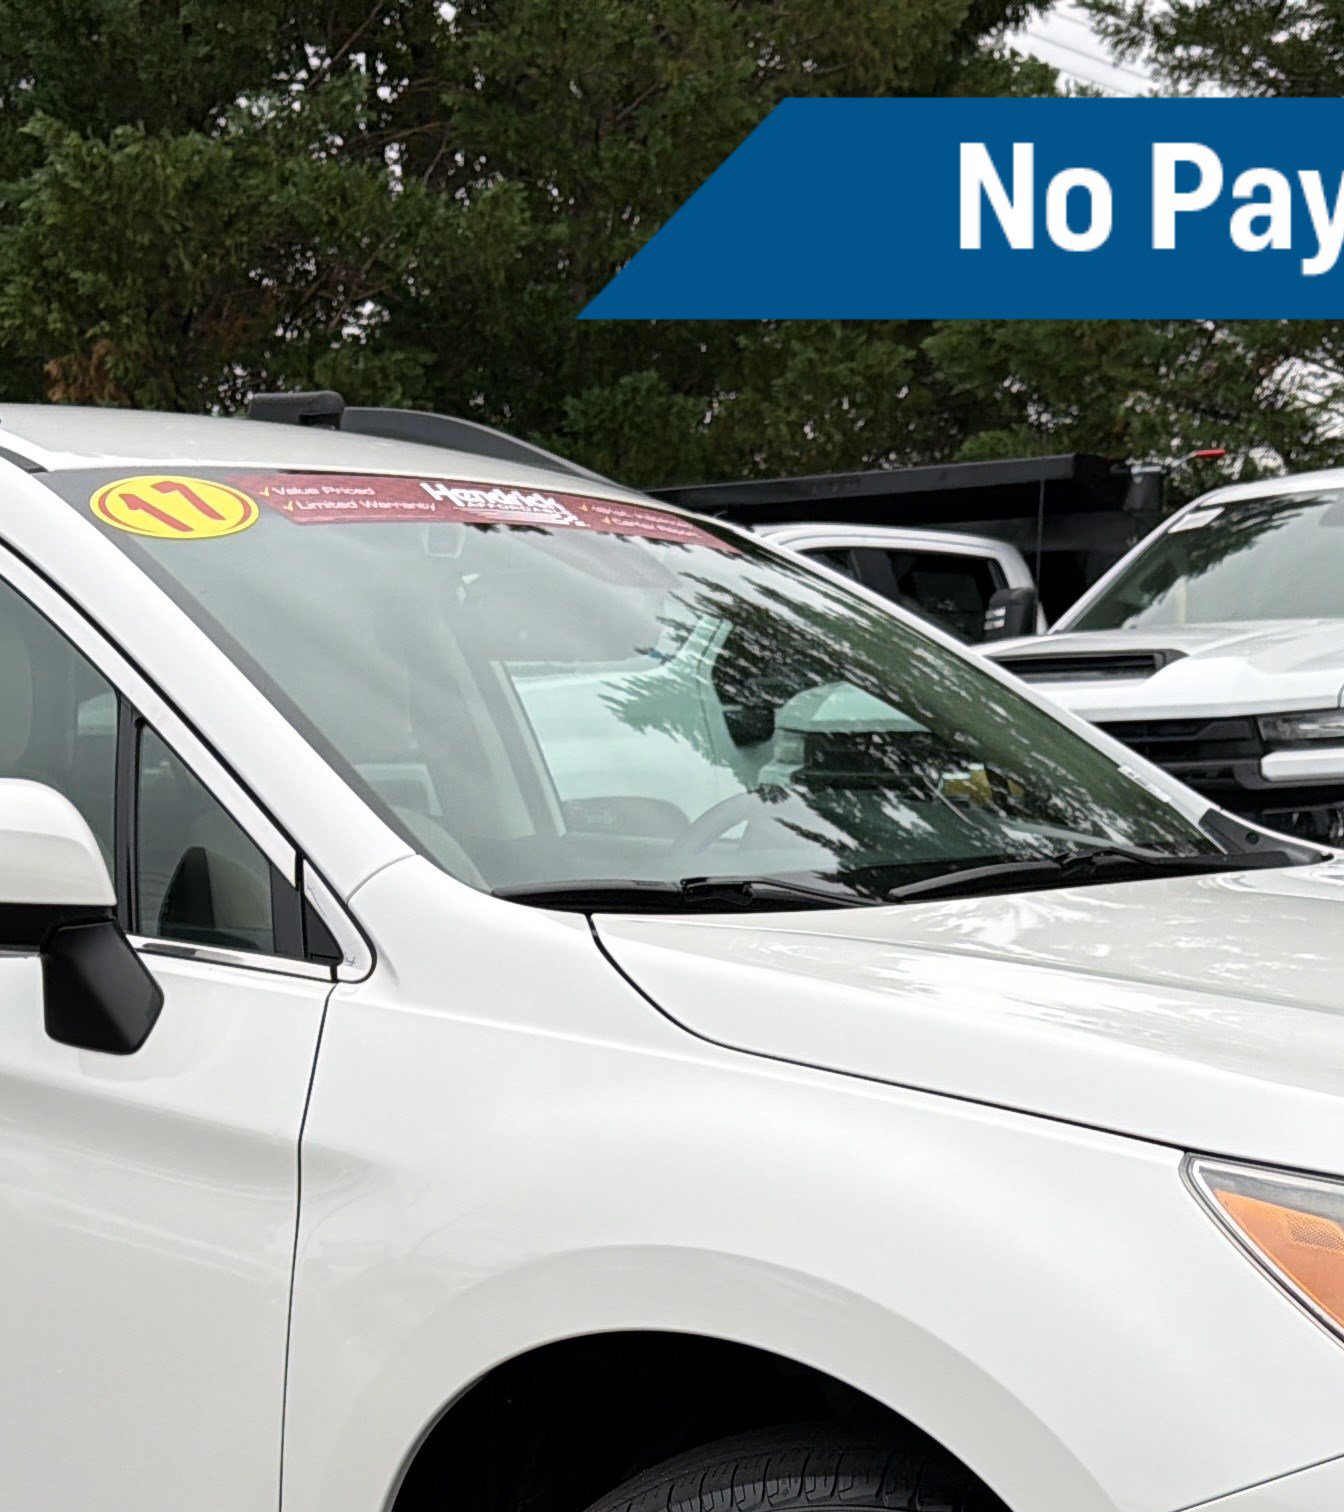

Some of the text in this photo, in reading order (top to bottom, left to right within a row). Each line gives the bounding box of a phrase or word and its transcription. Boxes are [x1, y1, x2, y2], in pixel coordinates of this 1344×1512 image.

[128, 480, 226, 532] 17
[295, 500, 436, 512] Limited Warranty
[420, 482, 562, 512] Hendrick
